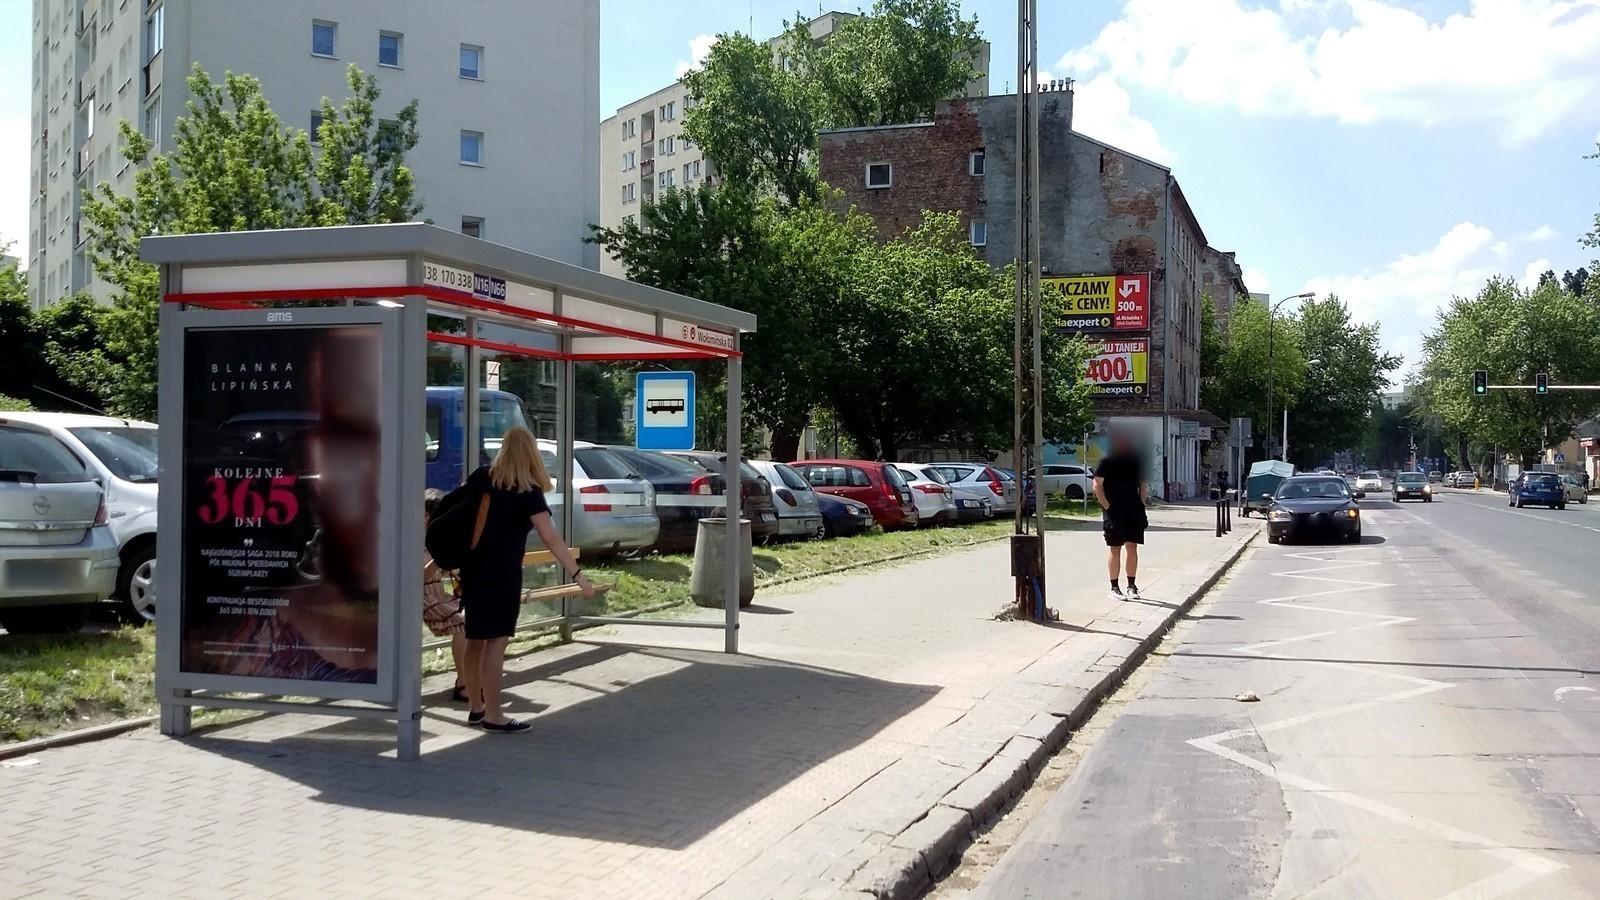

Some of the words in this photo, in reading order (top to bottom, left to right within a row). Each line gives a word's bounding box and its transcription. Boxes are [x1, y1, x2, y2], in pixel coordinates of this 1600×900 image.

[441, 269, 455, 285] 170
[457, 273, 473, 289] 338
[475, 276, 489, 292] N16
[491, 280, 506, 297] N66
[1053, 281, 1110, 297] ĄCZAMY
[1077, 298, 1110, 310] CENY!
[1117, 301, 1135, 311] 500
[267, 312, 293, 322] ams
[1114, 342, 1144, 352] TANIEJ!
[211, 361, 293, 374] BLANKA
[211, 379, 293, 391] LIPIŃSKA
[214, 467, 284, 479] KOLEJNE
[198, 475, 298, 524] 365
[234, 517, 262, 528] DNI
[265, 550, 280, 558] 2018
